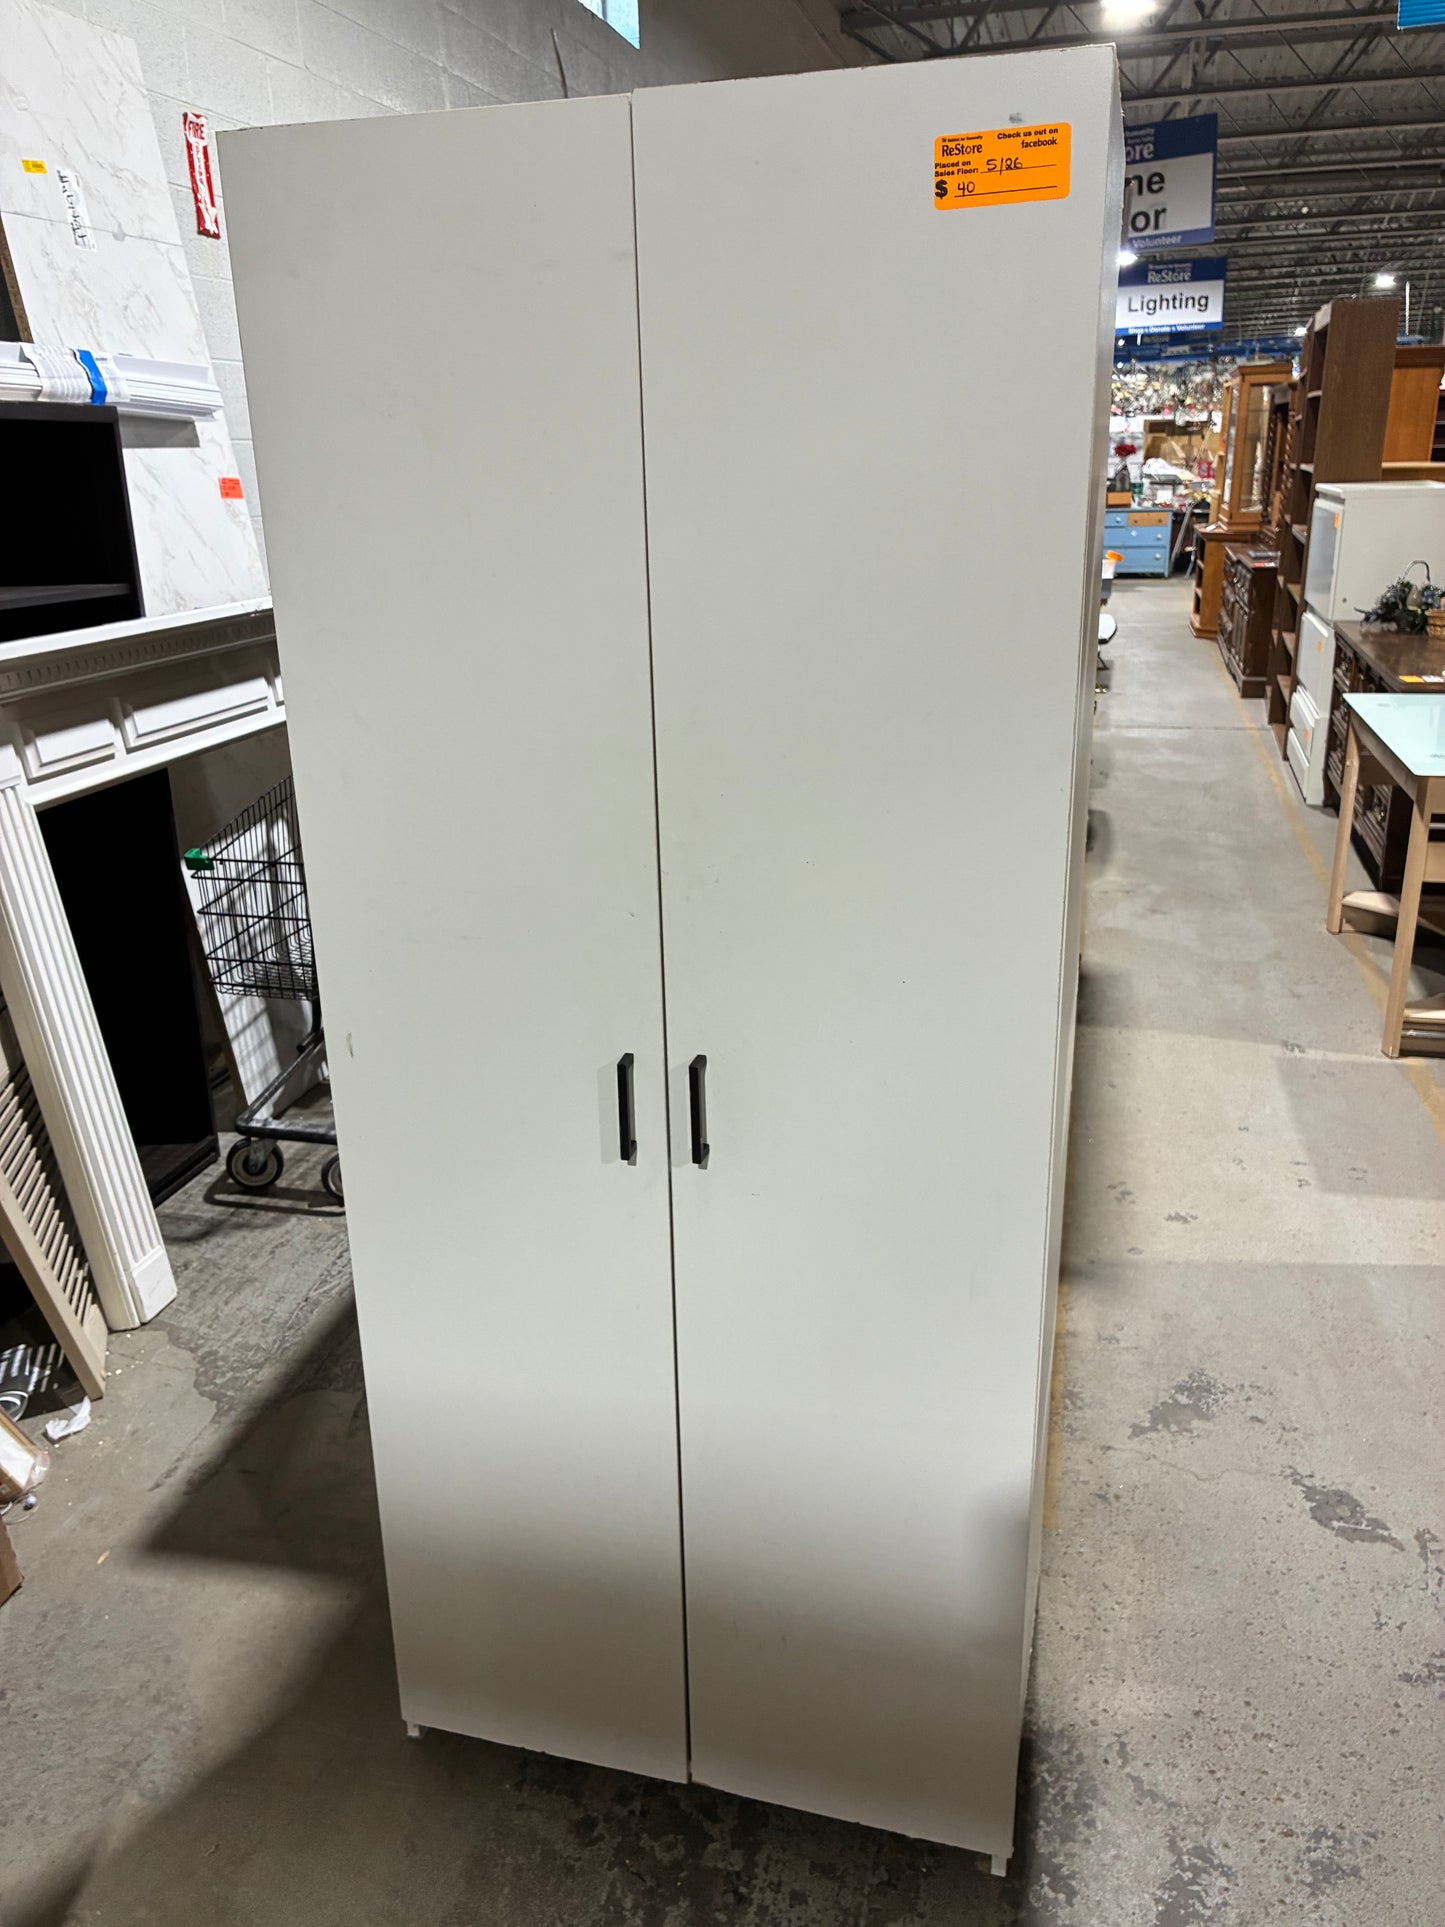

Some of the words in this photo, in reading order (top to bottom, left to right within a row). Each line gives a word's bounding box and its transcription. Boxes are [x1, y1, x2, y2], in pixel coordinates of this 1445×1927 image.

[188, 120, 205, 140] FIRE
[997, 131, 1021, 140] Check
[1021, 136, 1057, 149] facebook
[942, 143, 983, 157] ReStore
[935, 161, 960, 169] Placed
[935, 170, 955, 178] Sales
[957, 168, 979, 176] Floor:
[935, 179, 948, 200] $
[957, 181, 976, 197] 40
[1132, 235, 1182, 249] Volunteer
[1147, 269, 1192, 284] ReStore
[1128, 292, 1209, 316] Lighting
